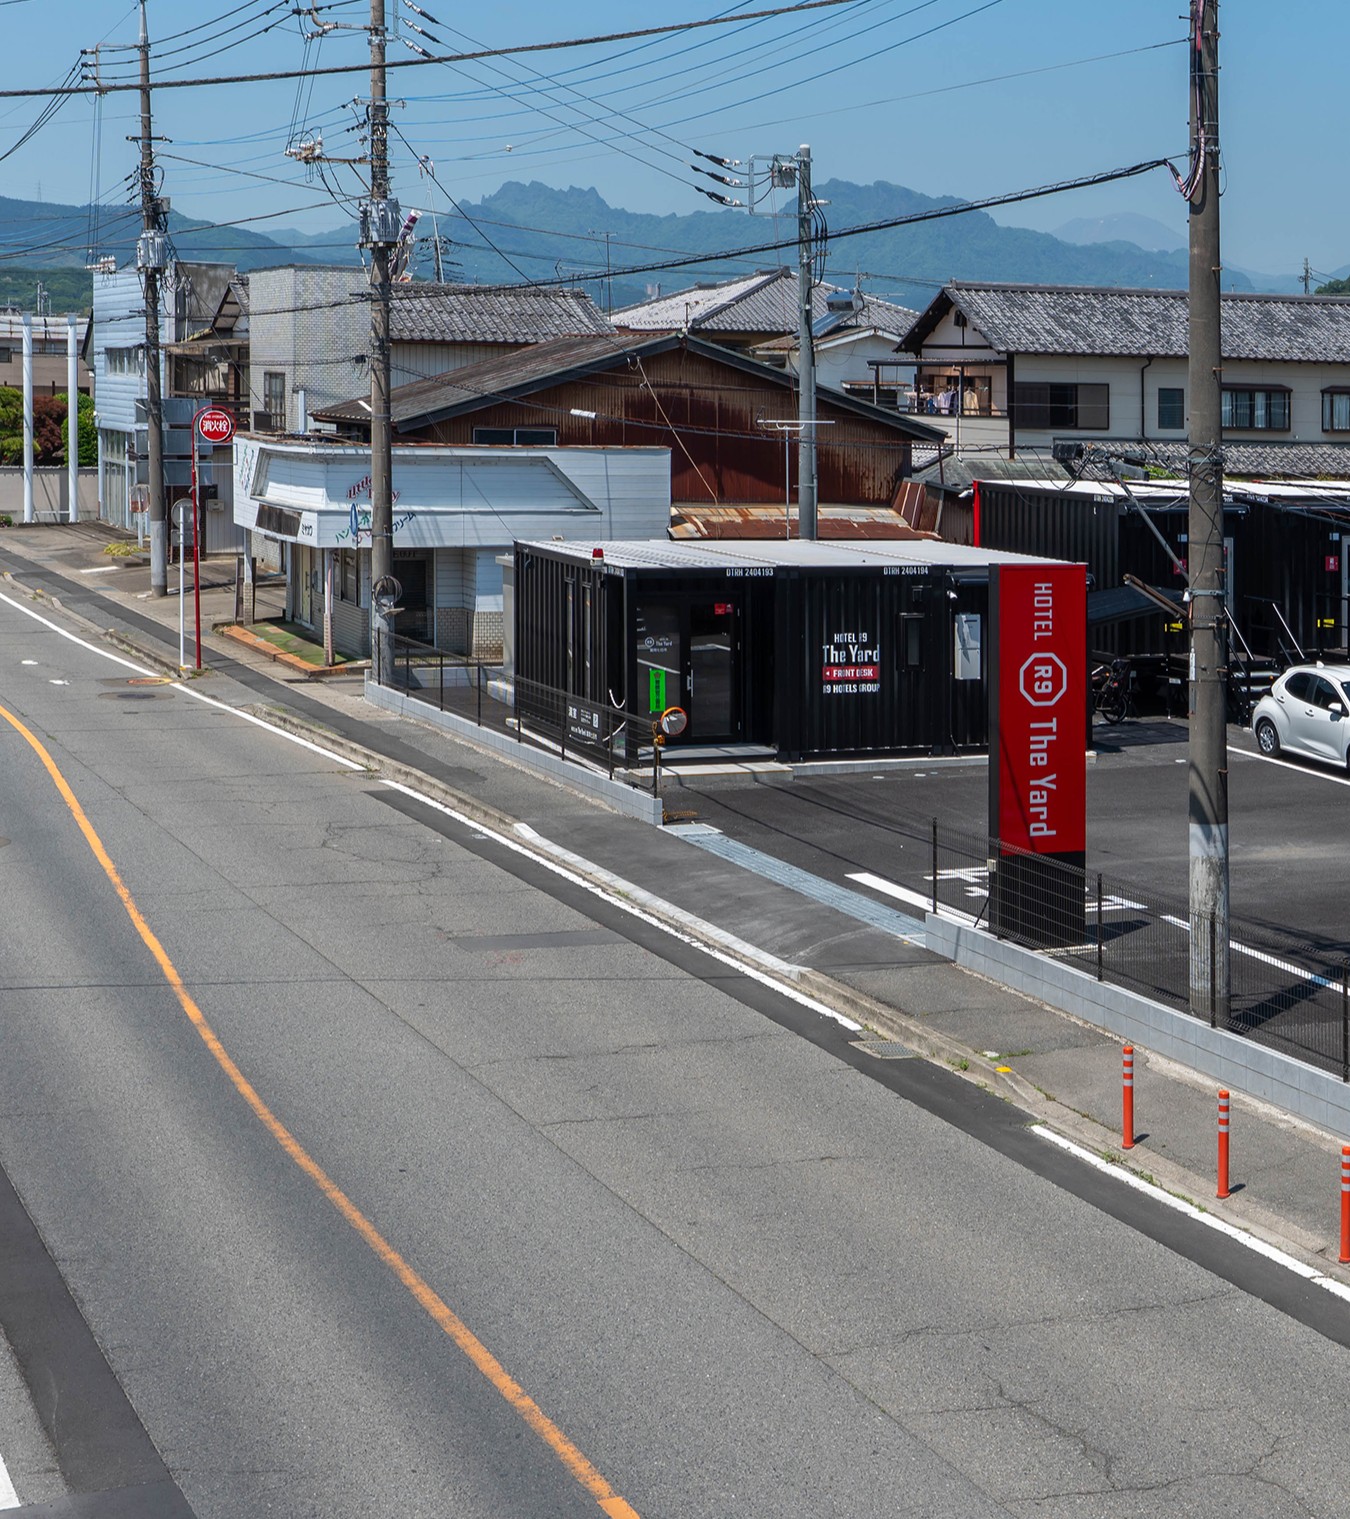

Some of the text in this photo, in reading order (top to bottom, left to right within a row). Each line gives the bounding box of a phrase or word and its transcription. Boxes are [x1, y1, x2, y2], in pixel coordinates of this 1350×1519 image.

[203, 419, 228, 432] 消火栓
[726, 567, 774, 577] DTRH 2404193
[883, 566, 929, 576] DTRH 2404194
[834, 632, 857, 643] HOTEL
[822, 644, 880, 663] The Yard
[832, 668, 874, 678] FRONT DESK
[832, 683, 858, 694] HOTELS
[858, 683, 880, 693] GROUP
[1029, 583, 1057, 837] HOTEL R9 The Yard
